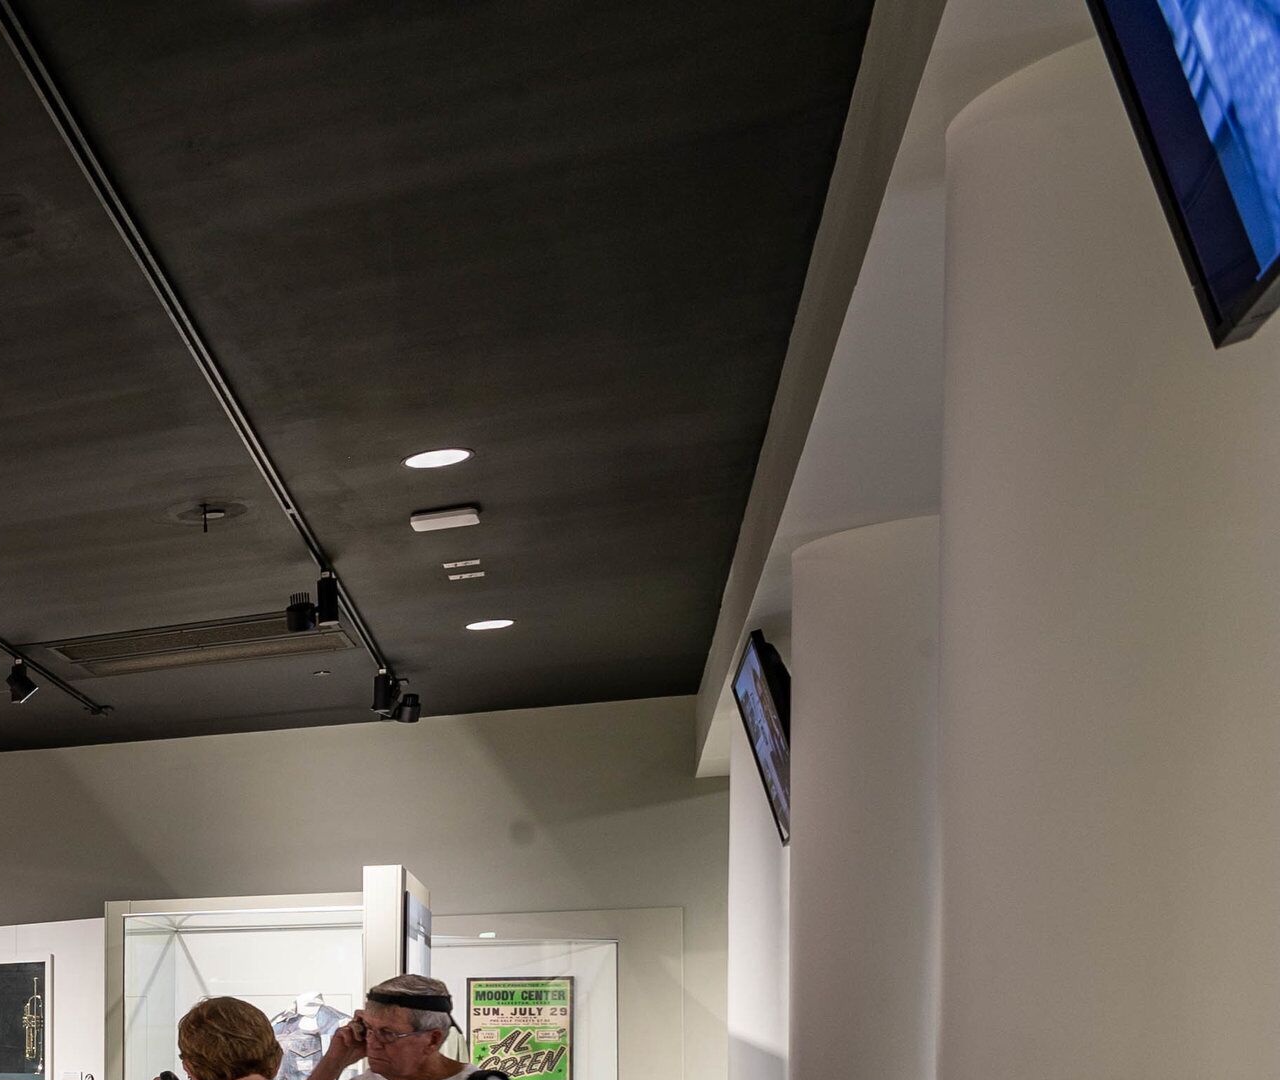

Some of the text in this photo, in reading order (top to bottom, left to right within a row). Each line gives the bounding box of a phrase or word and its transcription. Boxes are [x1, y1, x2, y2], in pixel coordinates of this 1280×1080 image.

[475, 990, 566, 1001] MOODY CENTER
[473, 1007, 568, 1017] SUN. JULY 29
[489, 1029, 533, 1055] AL
[479, 1045, 567, 1078] GREEN
